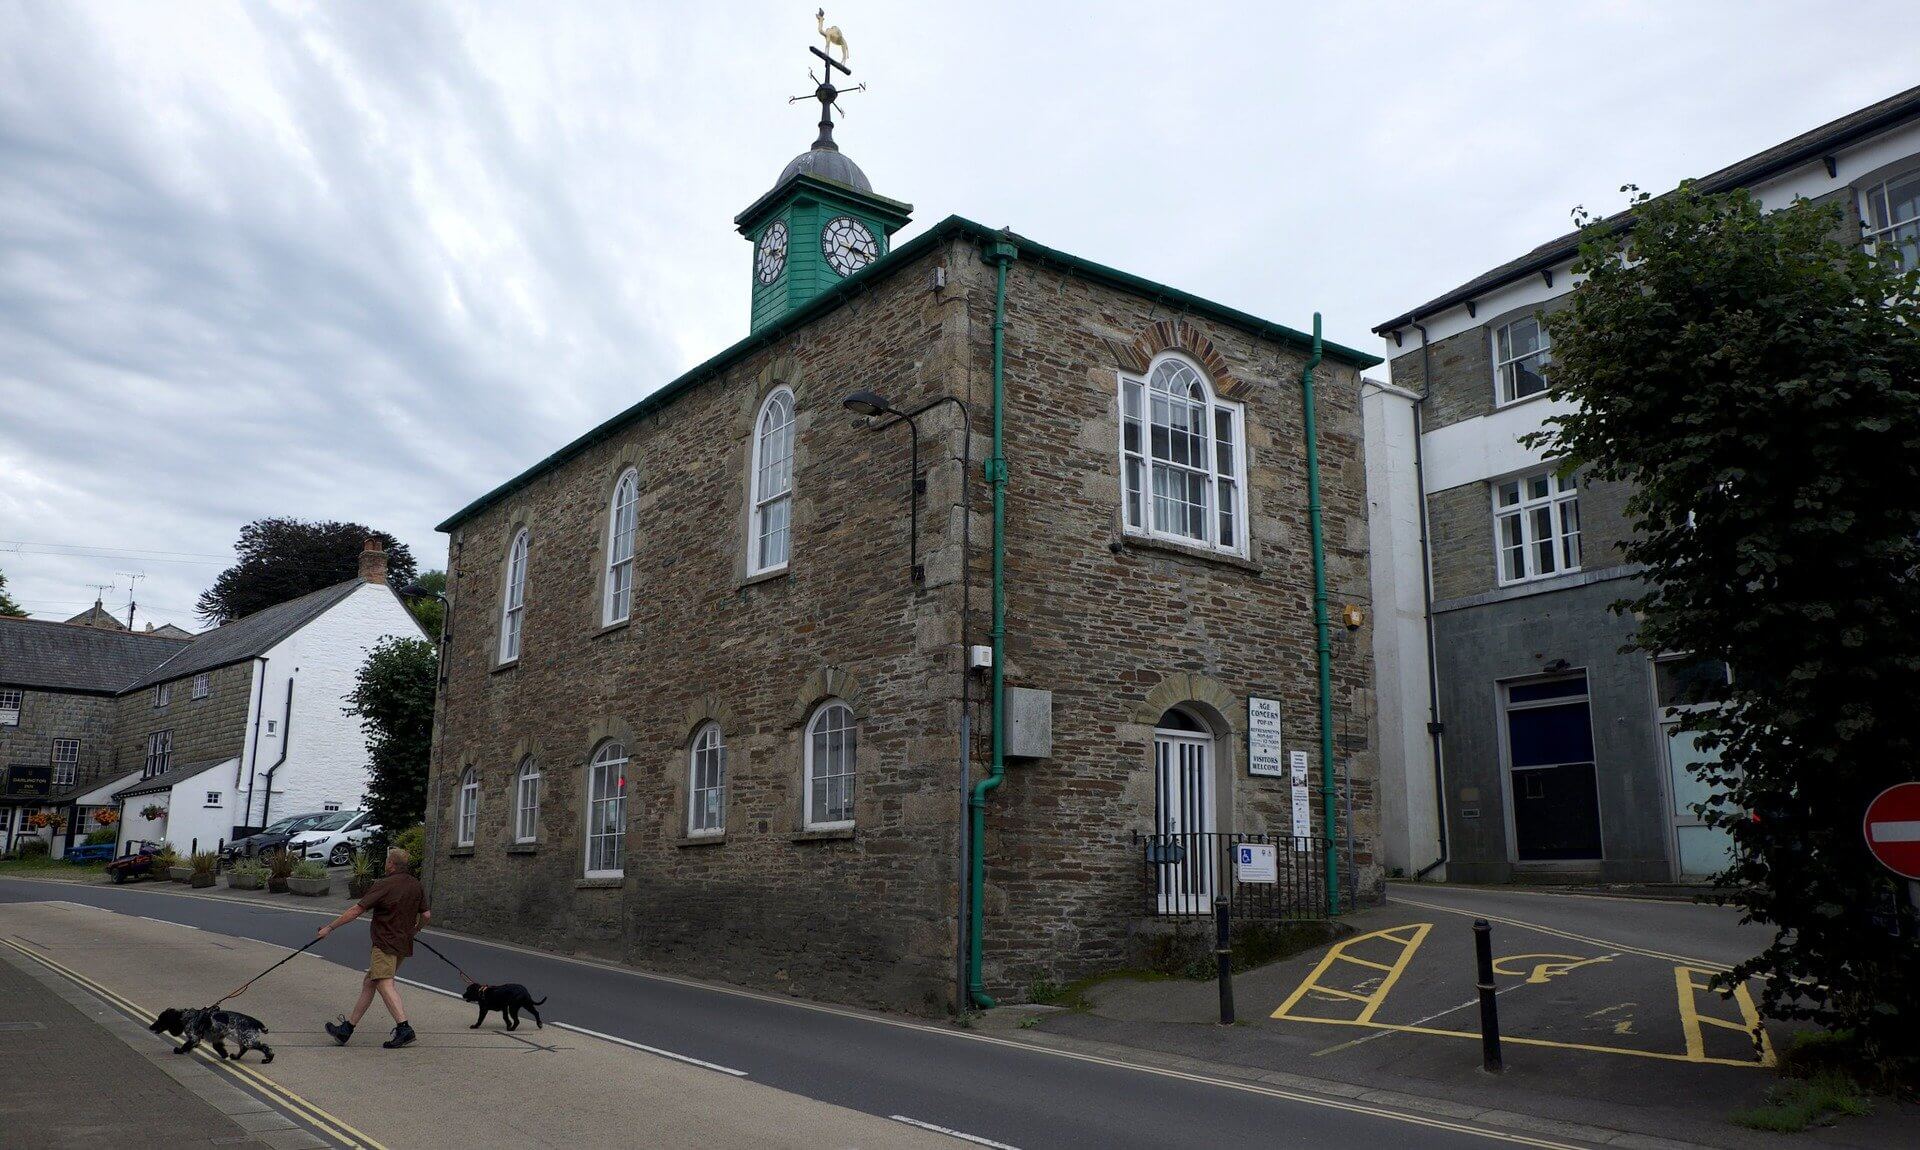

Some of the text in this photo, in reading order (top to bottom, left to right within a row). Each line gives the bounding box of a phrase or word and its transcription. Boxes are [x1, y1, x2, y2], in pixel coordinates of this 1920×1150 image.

[1259, 702, 1271, 711] AGE
[1251, 710, 1279, 719] CONCERN
[1253, 755, 1279, 764] VISITORS
[1252, 763, 1279, 771] WELCOME
